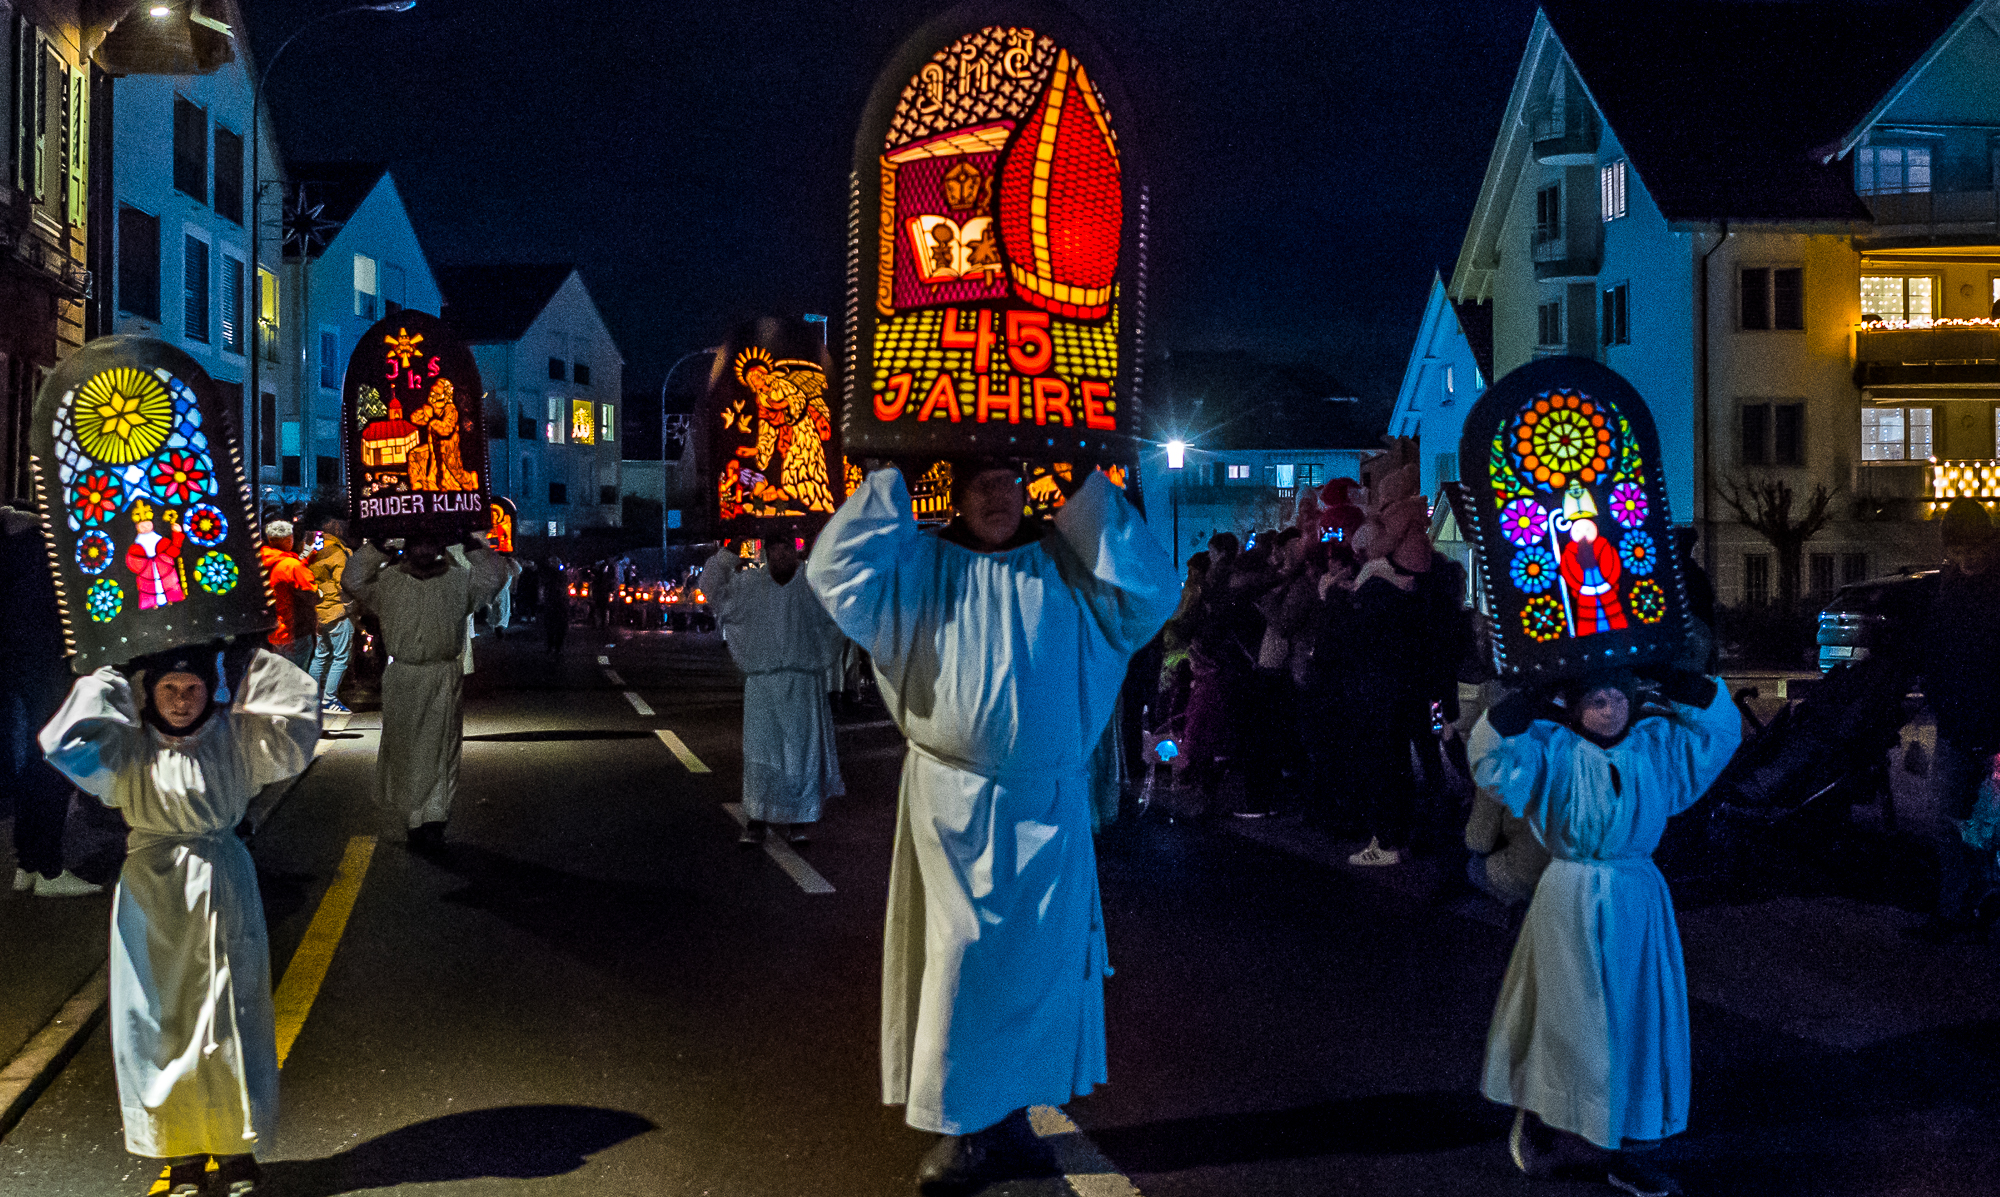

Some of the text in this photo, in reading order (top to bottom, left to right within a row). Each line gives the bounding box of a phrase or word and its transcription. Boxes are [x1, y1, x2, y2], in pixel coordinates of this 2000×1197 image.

[941, 308, 1053, 375] 45
[873, 373, 1117, 431] JAHRE
[360, 492, 482, 519] BRUDER KLAUS
